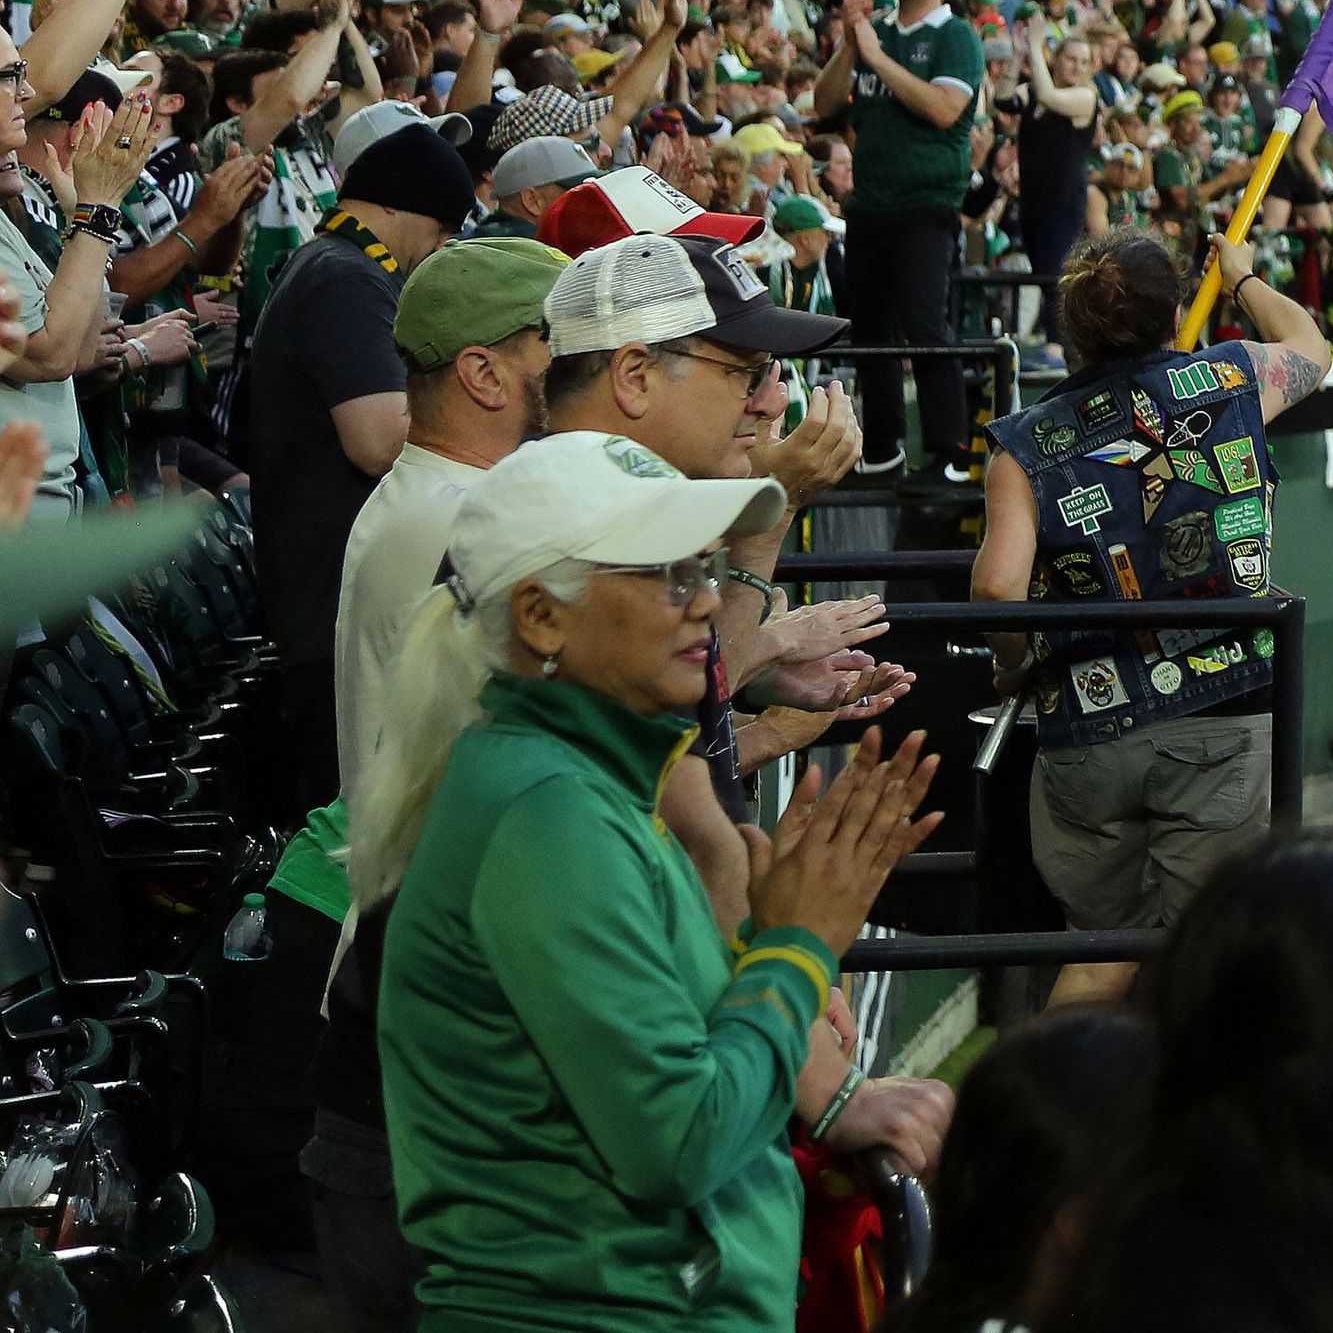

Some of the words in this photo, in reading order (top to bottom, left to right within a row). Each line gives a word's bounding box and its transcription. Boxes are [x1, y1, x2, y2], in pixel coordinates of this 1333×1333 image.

[1065, 496, 1085, 510] KEEP
[1088, 489, 1103, 501] ON
[1067, 509, 1085, 520] THE
[1083, 500, 1107, 514] GRASS
